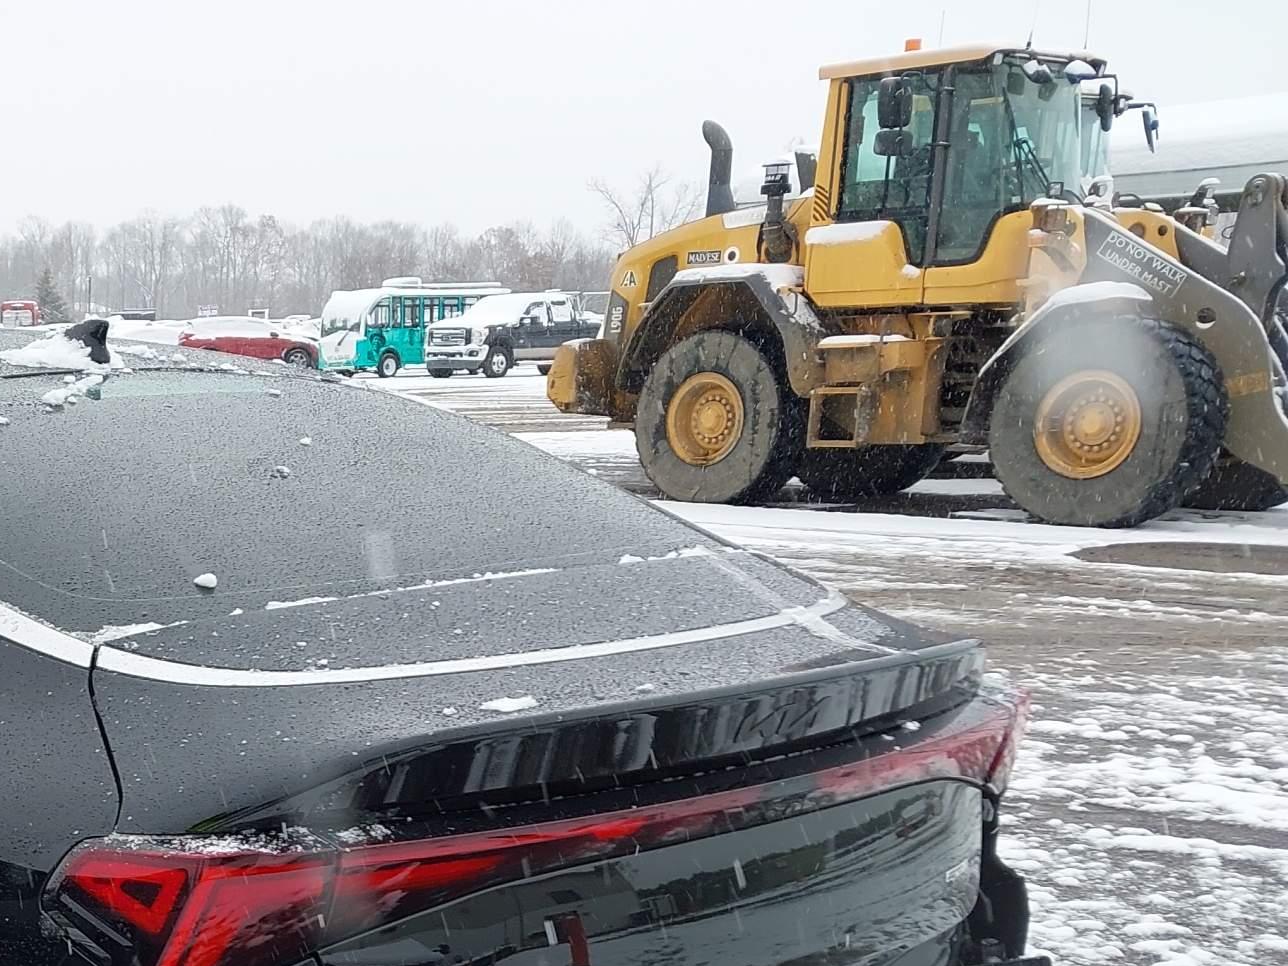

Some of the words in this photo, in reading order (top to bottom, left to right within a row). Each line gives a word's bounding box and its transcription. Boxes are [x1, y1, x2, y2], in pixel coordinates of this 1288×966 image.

[1106, 250, 1142, 279] UNDER
[1141, 271, 1173, 294] MAST
[1108, 233, 1126, 248] DO
[1126, 244, 1151, 262] NOT
[1152, 259, 1184, 283] WALK
